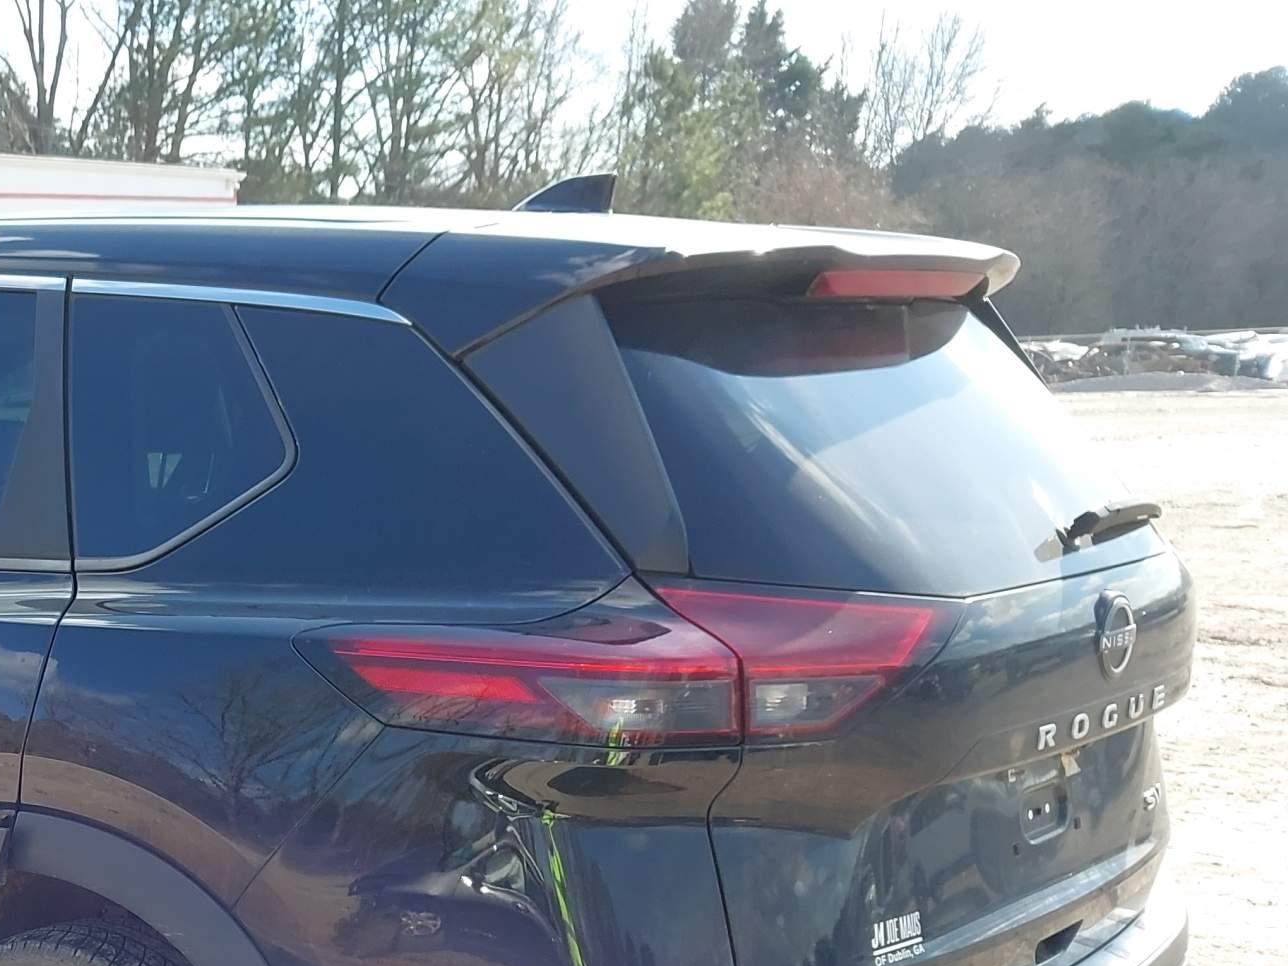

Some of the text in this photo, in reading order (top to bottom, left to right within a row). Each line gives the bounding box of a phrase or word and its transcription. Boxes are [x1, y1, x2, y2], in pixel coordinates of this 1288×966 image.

[1038, 685, 1165, 750] ROGUE
[886, 917, 900, 945] JOE
[899, 911, 922, 940] MAUS
[887, 948, 914, 964] Dublin,
[912, 944, 926, 956] GA
